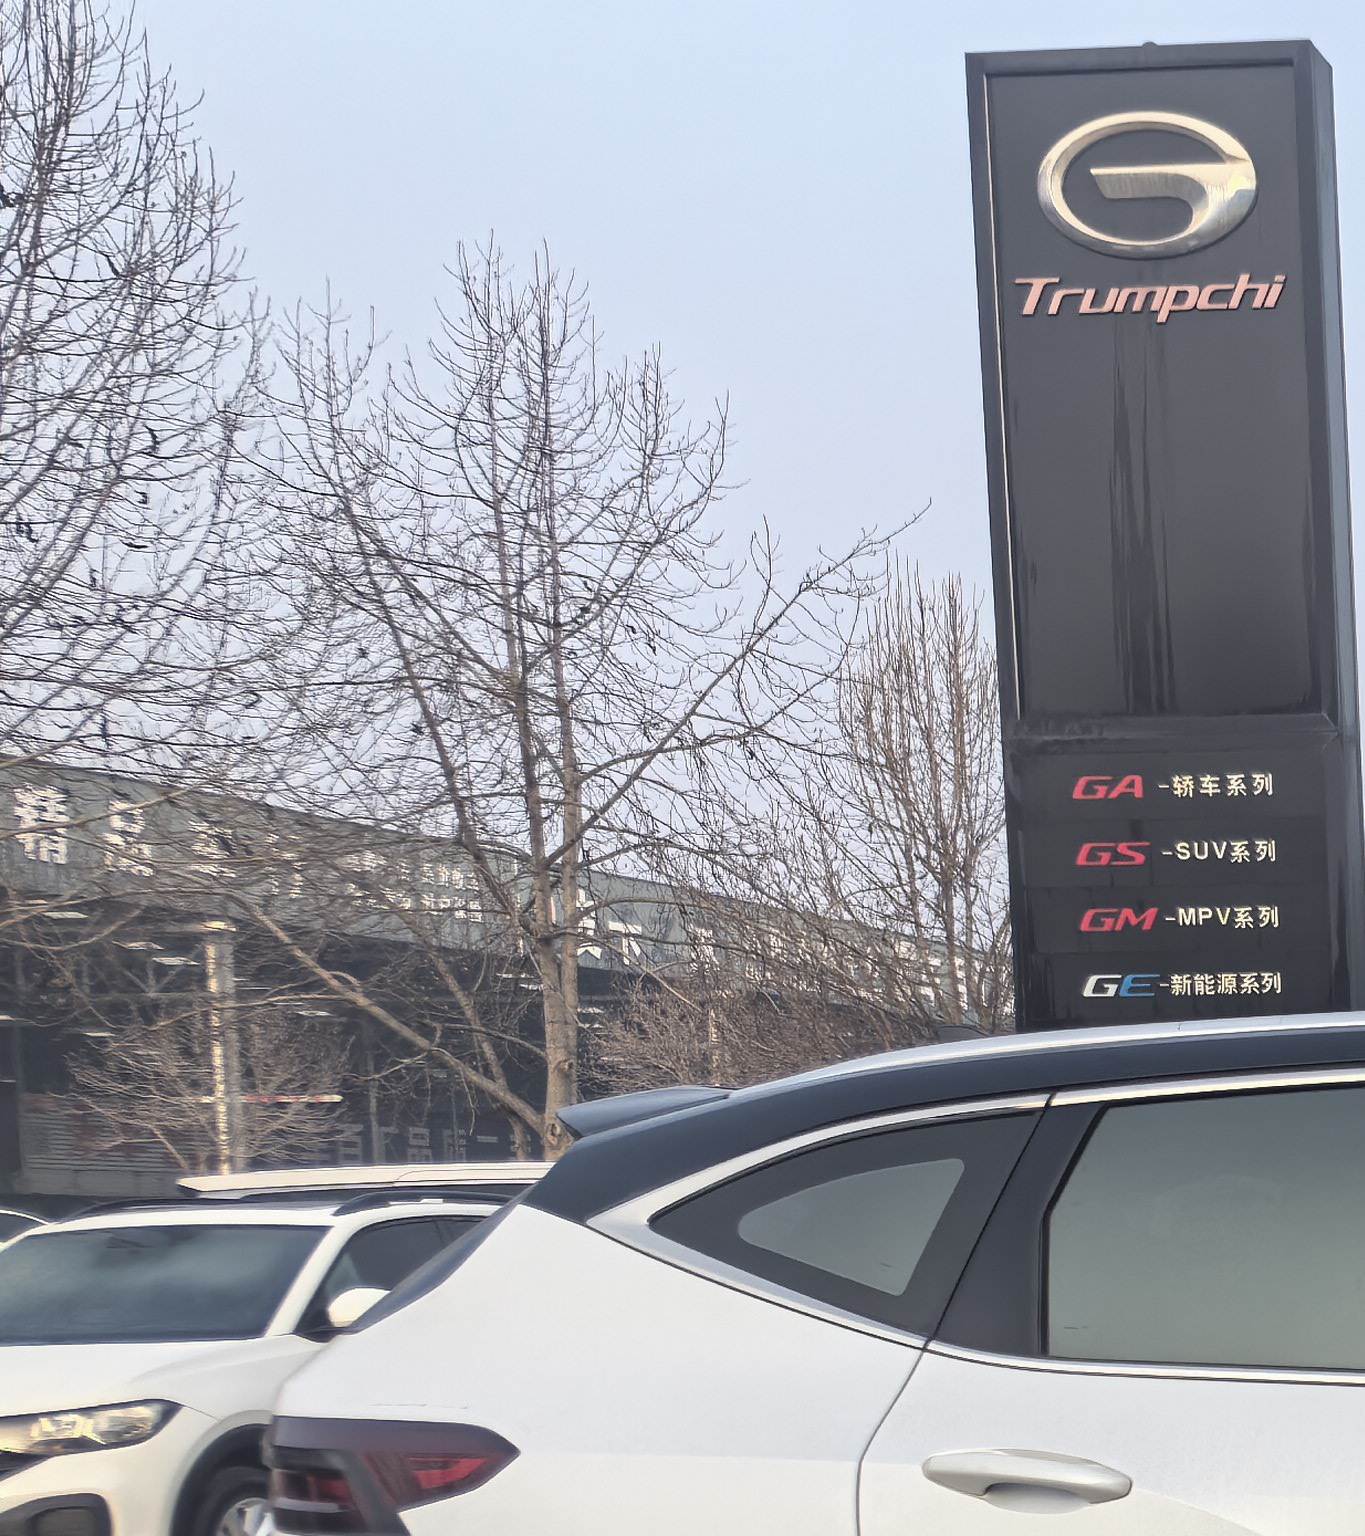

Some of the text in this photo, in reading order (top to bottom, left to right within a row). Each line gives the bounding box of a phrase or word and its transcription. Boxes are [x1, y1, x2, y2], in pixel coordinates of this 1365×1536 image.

[1014, 274, 1287, 324] Trumpchi
[1072, 774, 1145, 801] GA
[1075, 842, 1151, 867] GS
[1078, 907, 1159, 932] GM
[1082, 973, 1160, 998] GE
